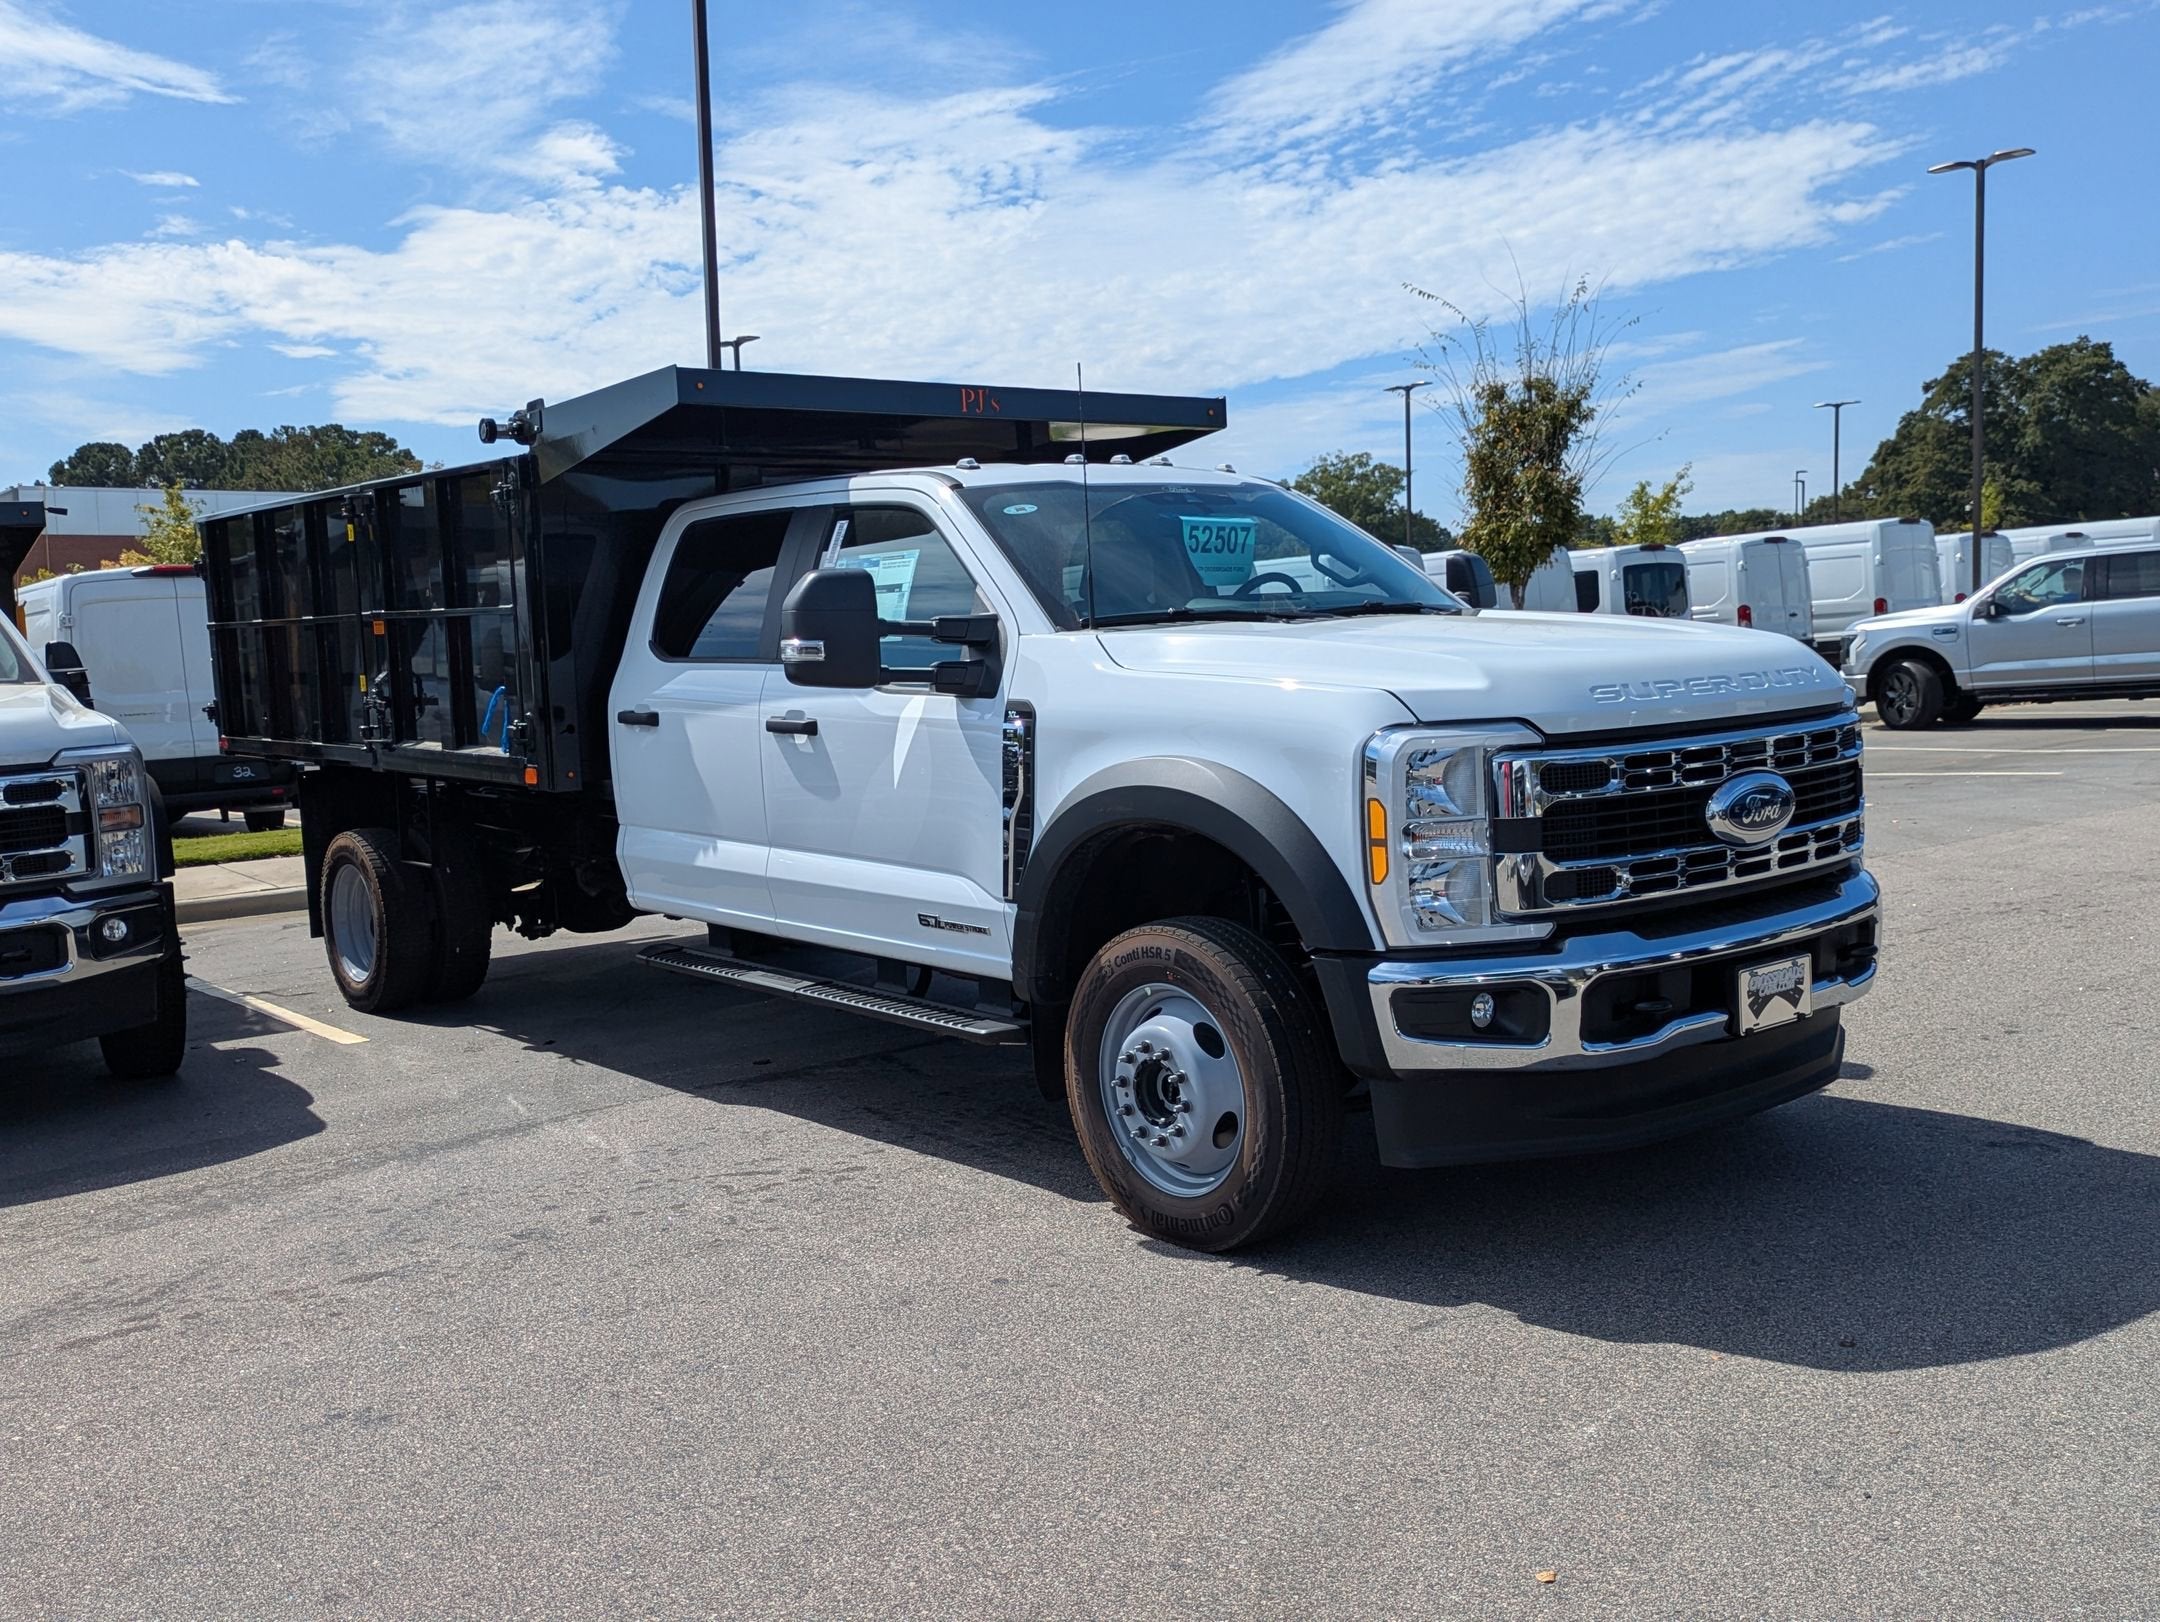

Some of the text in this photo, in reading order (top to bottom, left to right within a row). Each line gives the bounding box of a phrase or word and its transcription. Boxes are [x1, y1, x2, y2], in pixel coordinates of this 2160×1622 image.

[961, 388, 1000, 414] PJ's
[1188, 525, 1251, 555] 52507
[1588, 665, 1821, 704] SUPER DUTY
[233, 766, 255, 778] 32
[1742, 793, 1783, 824] Ford
[1114, 945, 1172, 968] Conti HSR 5
[1151, 1203, 1235, 1235] Continental
